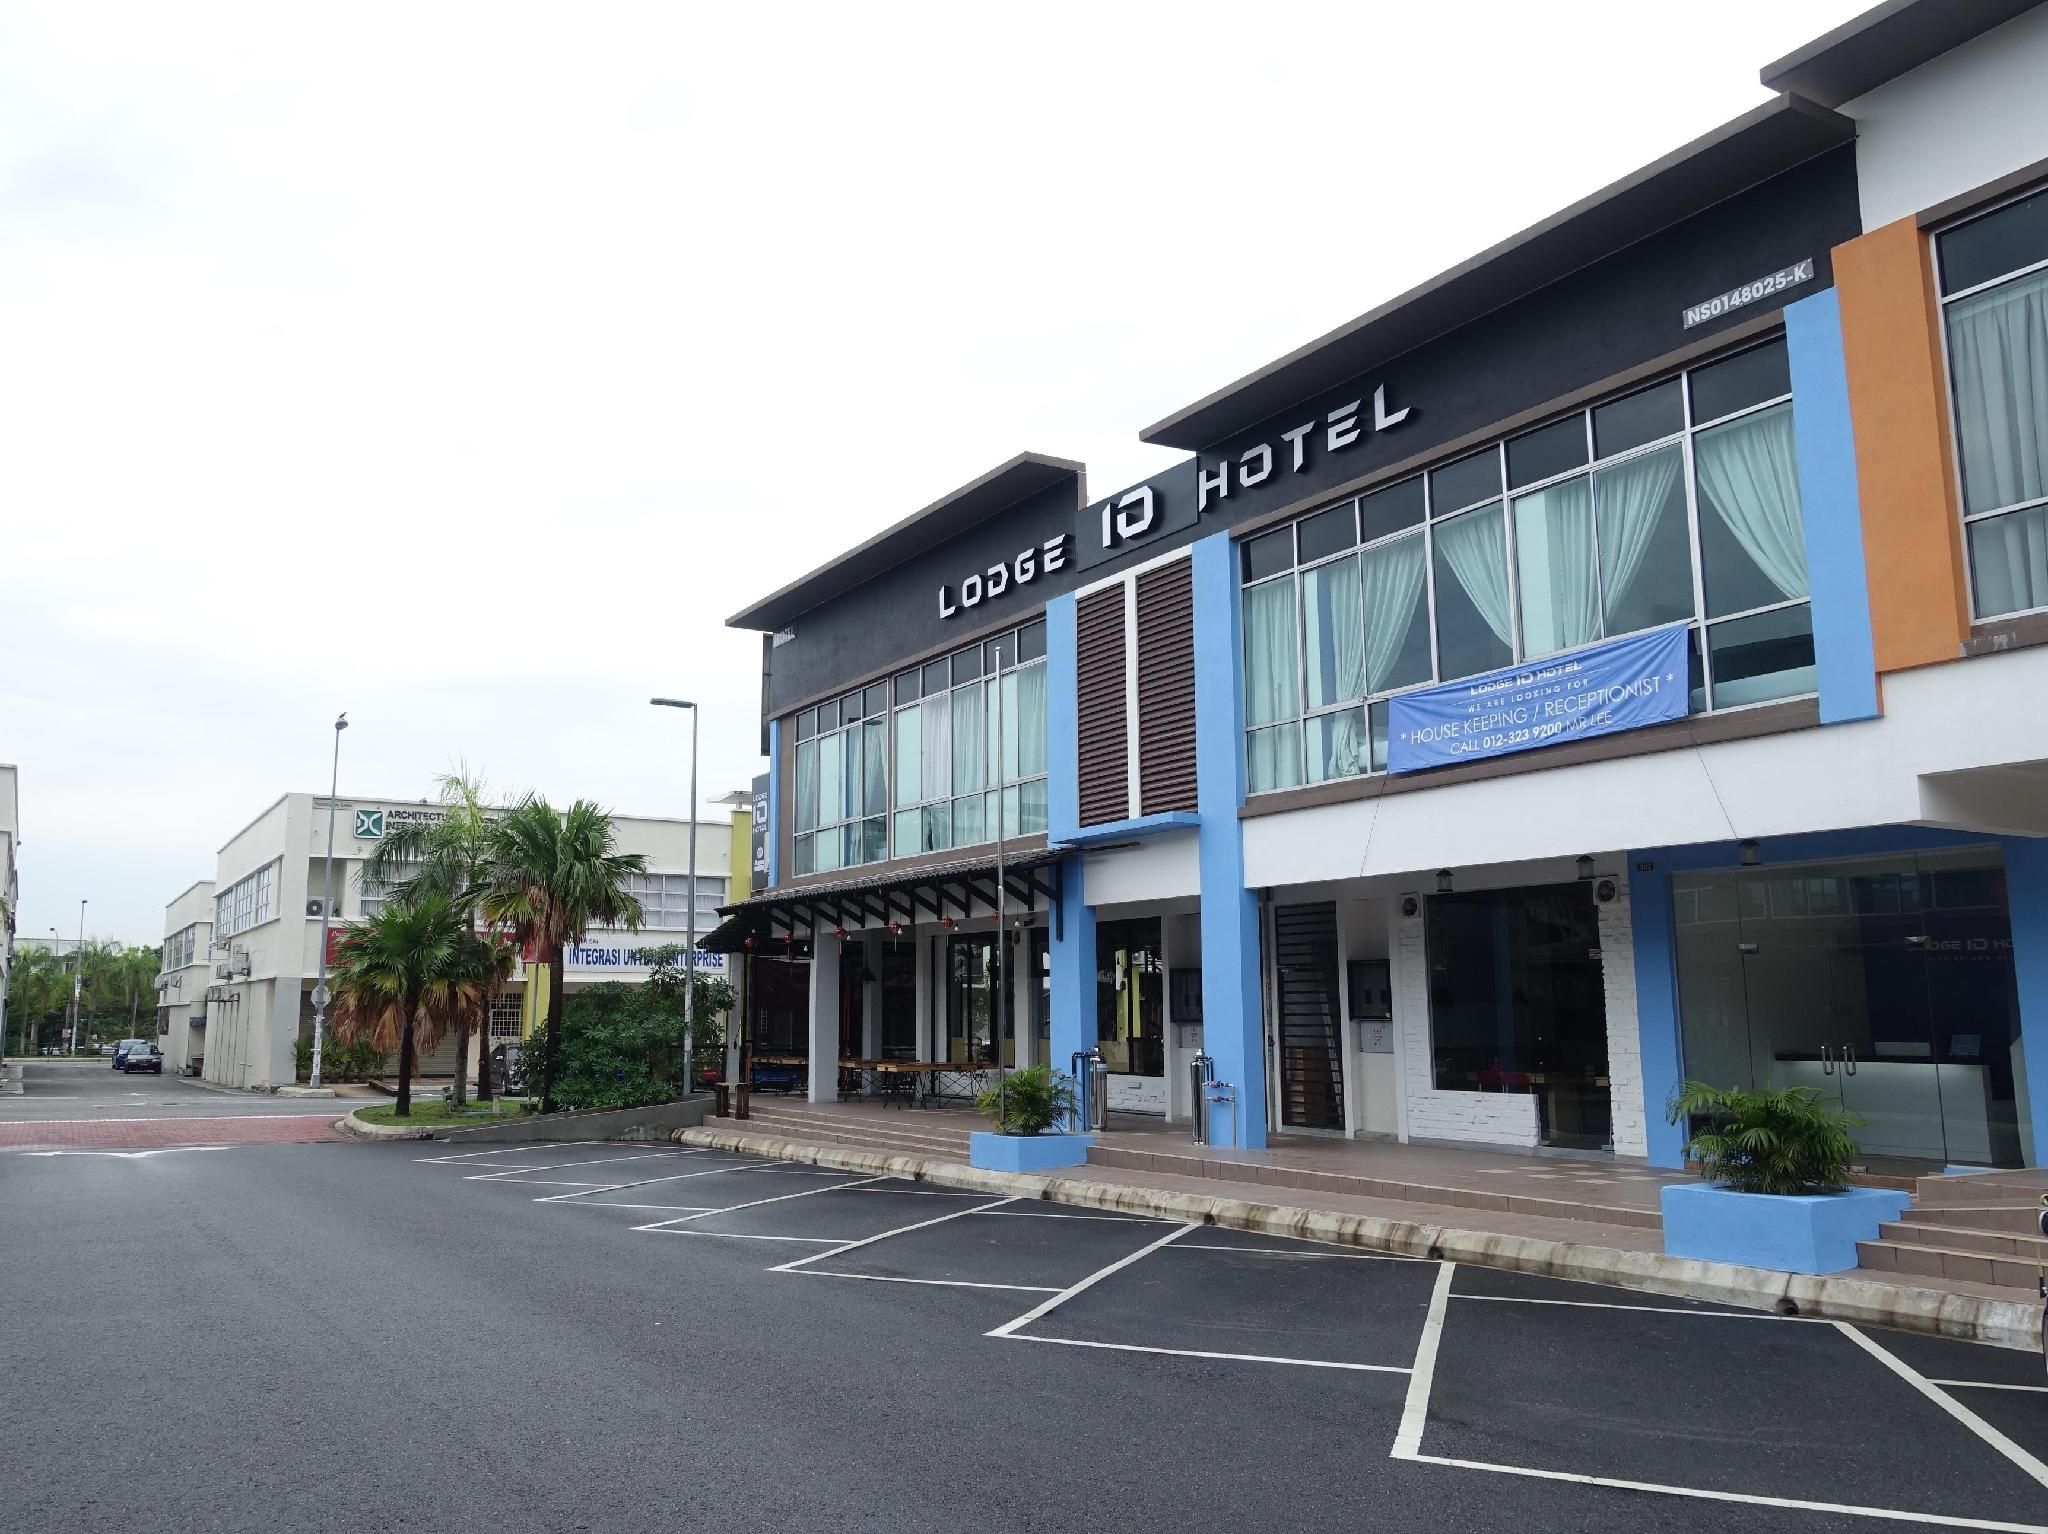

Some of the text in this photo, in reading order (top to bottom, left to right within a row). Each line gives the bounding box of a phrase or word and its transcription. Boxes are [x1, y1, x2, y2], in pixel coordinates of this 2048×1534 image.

[1687, 263, 1807, 324] NS0148025-K
[939, 533, 1066, 619] LODGE
[1199, 383, 1411, 512] HOTEL
[1468, 679, 1588, 713] WE ARE LOOKING FOR
[1470, 678, 1513, 696] LODGE
[1537, 660, 1582, 681] HOTEL
[1411, 722, 1460, 745] HOUSE
[1464, 707, 1528, 735] KEEPING
[1545, 676, 1661, 717] RECEPTIONIST
[1450, 710, 1613, 755] CALL 012-323 9200 MR LEE
[387, 810, 452, 821] ARCHITECTU
[569, 947, 621, 966] INTEGRASI
